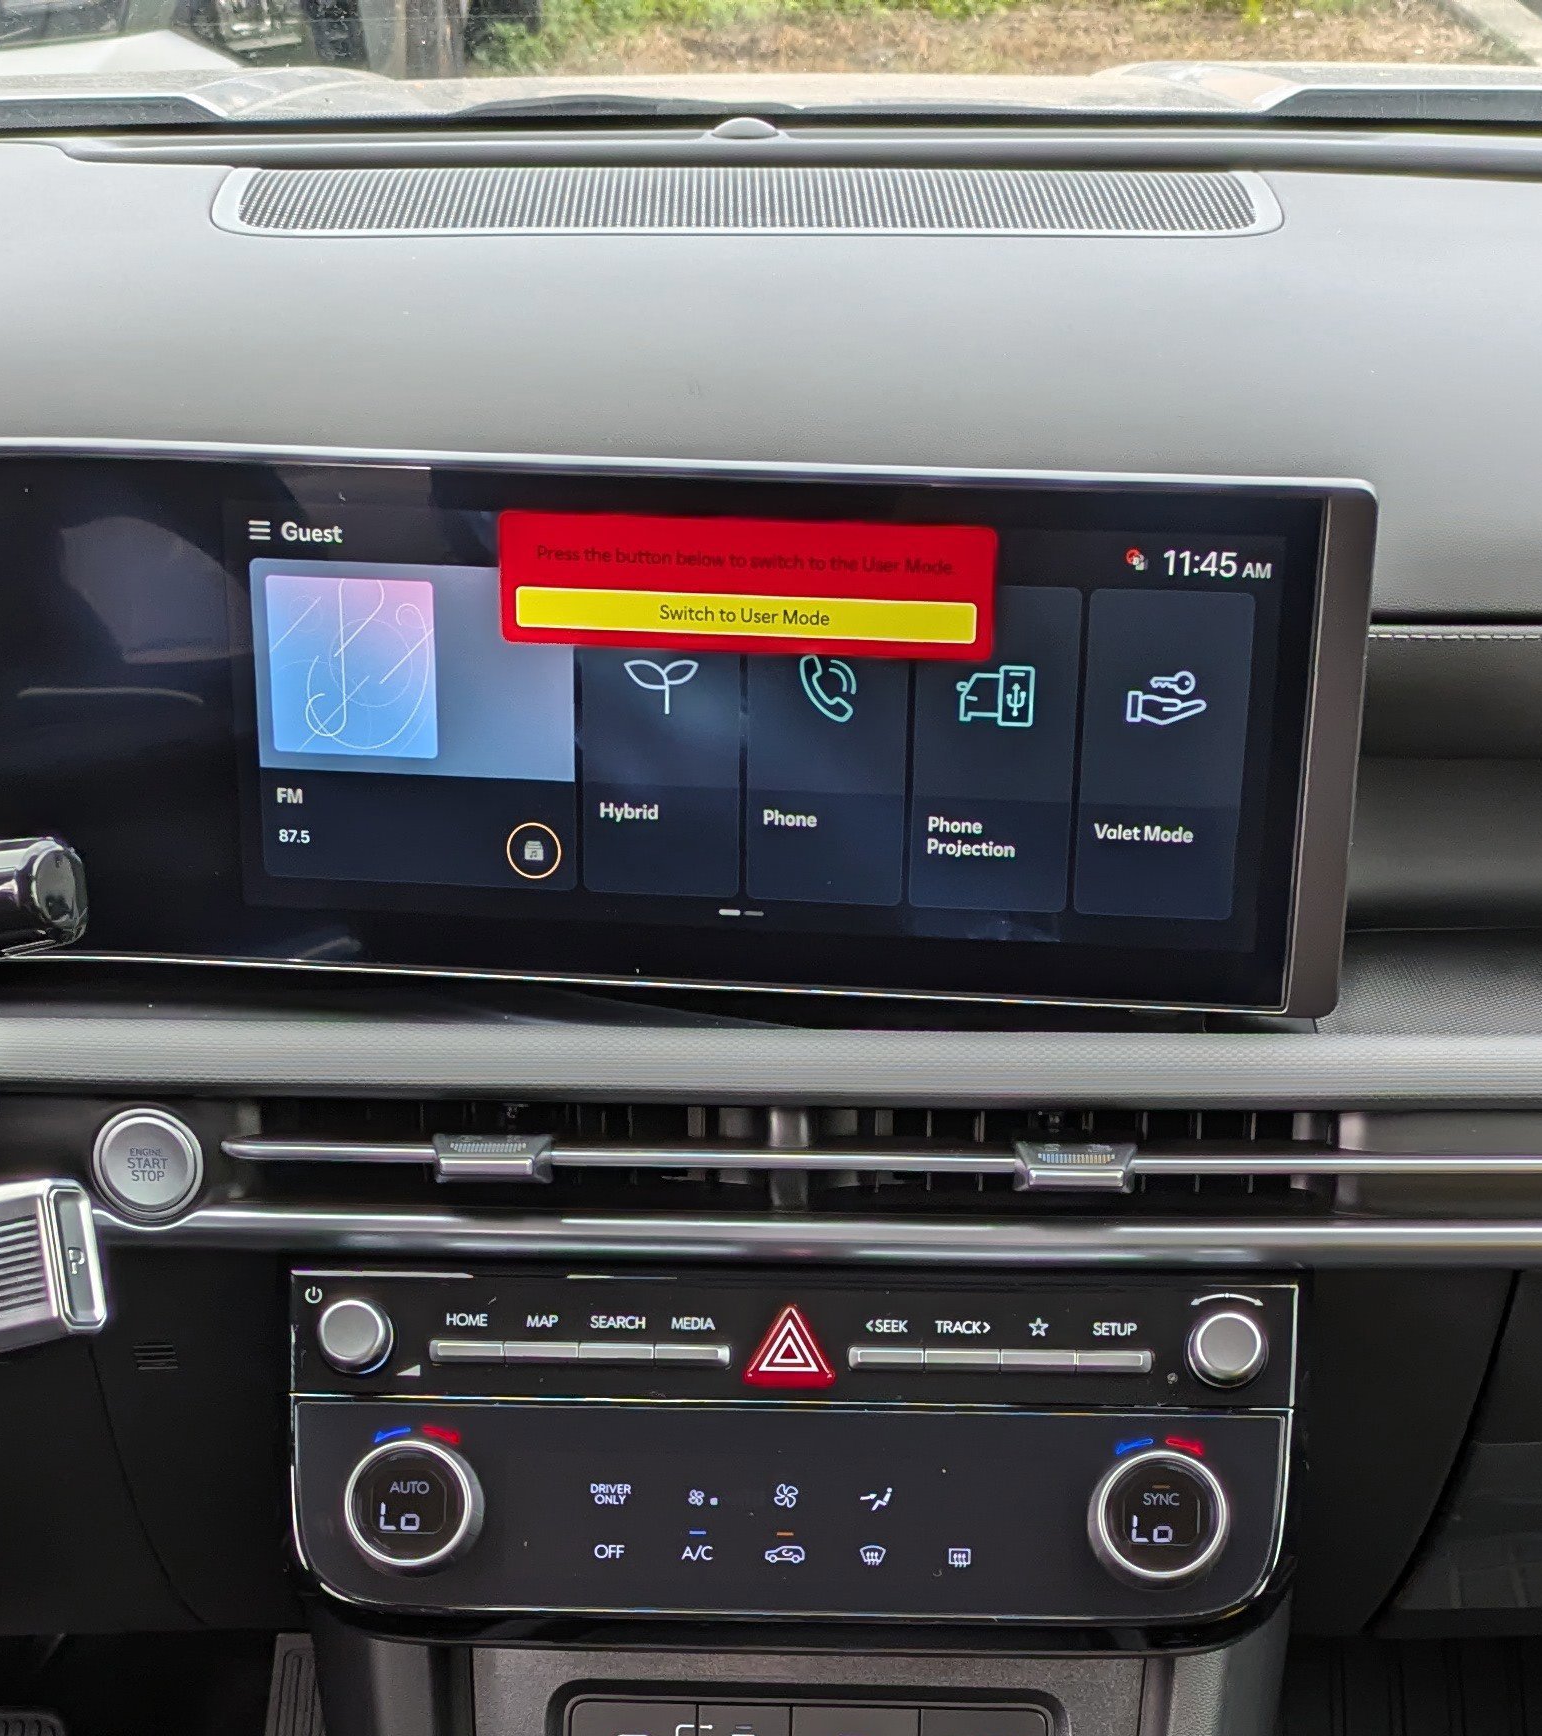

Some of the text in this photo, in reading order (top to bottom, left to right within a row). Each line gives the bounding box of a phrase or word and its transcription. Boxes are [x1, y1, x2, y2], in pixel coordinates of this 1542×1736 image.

[281, 521, 343, 544] Guest
[536, 545, 953, 575] Press the button below to switch to the User Mode
[1163, 550, 1273, 580] 11:45 AM
[659, 604, 830, 626] Switch to User Mode
[276, 787, 303, 804] FM
[599, 802, 659, 823] Hybrid
[763, 809, 818, 828] Phone
[928, 816, 983, 835] Phone
[1093, 823, 1194, 844] Valet Mode
[278, 829, 310, 844] 87.5
[926, 838, 1016, 858] Projection
[129, 1148, 162, 1157] ENGINE
[127, 1157, 168, 1170] START
[131, 1170, 165, 1182] STOP
[68, 1247, 85, 1275] P
[445, 1313, 716, 1332] HOME MAP SEARCH MEDIA
[1092, 1321, 1137, 1337] SETUP
[390, 1481, 429, 1496] AUTO
[590, 1483, 632, 1495] DRIVER
[594, 1494, 627, 1506] ONLY
[1142, 1492, 1180, 1507] SYNC
[594, 1545, 625, 1560] OFF
[681, 1545, 714, 1561] A/C
